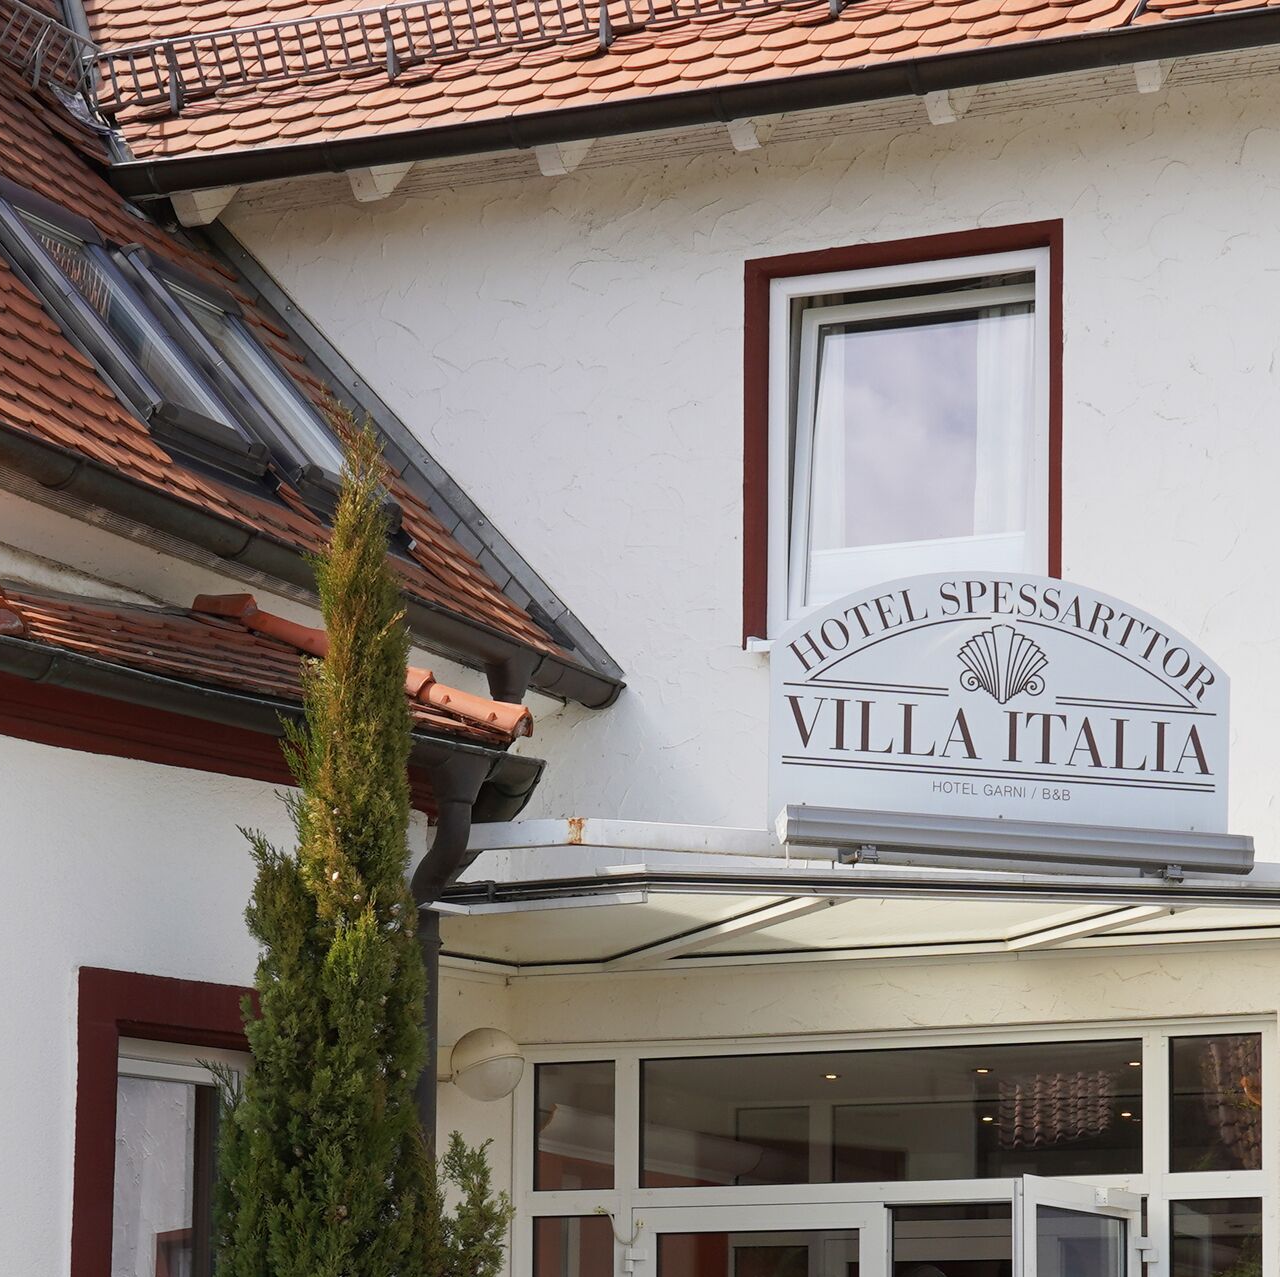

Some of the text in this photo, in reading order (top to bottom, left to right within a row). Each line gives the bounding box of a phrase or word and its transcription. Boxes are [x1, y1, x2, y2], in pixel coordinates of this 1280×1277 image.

[787, 580, 1216, 702] HOTEL SPESSARTTOR
[783, 694, 1215, 775] VILLA ITALIA
[931, 780, 978, 796] HOTEL
[982, 783, 1027, 799] GARNI
[1041, 787, 1071, 801] B&B
